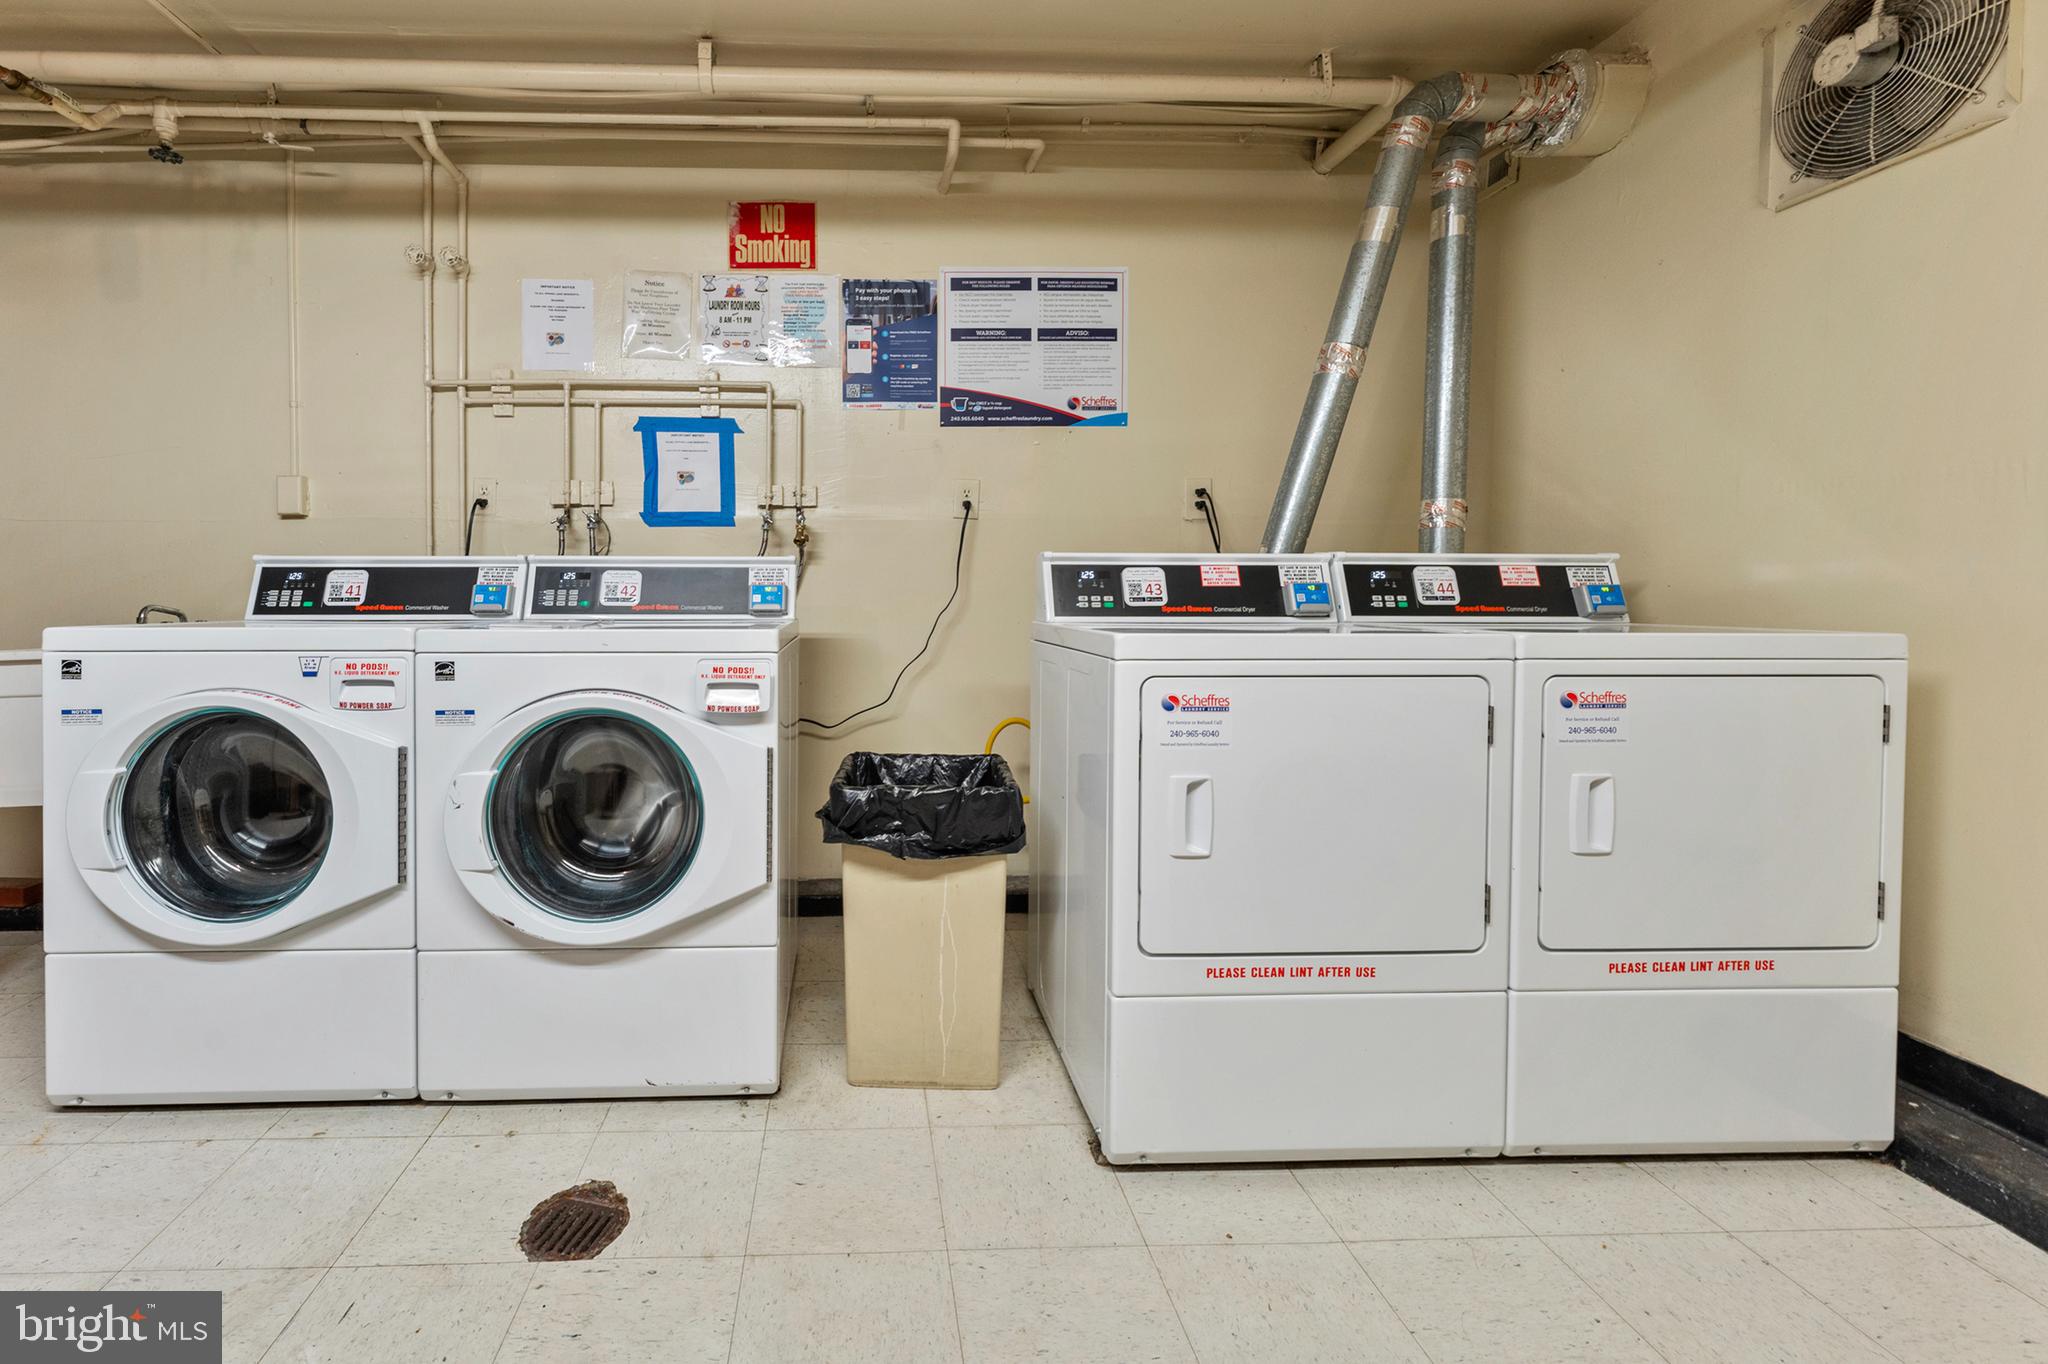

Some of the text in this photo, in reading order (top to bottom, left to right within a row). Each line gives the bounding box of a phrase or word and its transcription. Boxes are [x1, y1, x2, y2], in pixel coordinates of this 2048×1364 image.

[760, 204, 785, 233] NO
[735, 234, 810, 268] Smoking
[709, 301, 760, 310] LAUNDRY ROOM HOURS
[1082, 396, 1117, 406] Scheffres
[345, 585, 361, 596] 41
[620, 585, 637, 597] 42
[1145, 583, 1163, 596] 43
[1437, 582, 1455, 594] 44
[355, 604, 379, 612] Speed
[405, 604, 431, 612] Commercial
[432, 604, 449, 612] Washer
[1455, 605, 1480, 613] Speed
[1506, 605, 1534, 613] Commercial
[1534, 605, 1548, 613] Dryer
[712, 666, 755, 674] NO PODS!!
[1181, 694, 1230, 707] Scheffres
[1579, 691, 1627, 704] Scheffres
[1169, 730, 1220, 738] 240-965-6040
[1568, 726, 1617, 734] 240-965-6040
[1206, 967, 1376, 978] PLEASE CLEAN LINT AFTER USE
[1609, 960, 1775, 974] PLEASE CLEAN LINT AFTER USE
